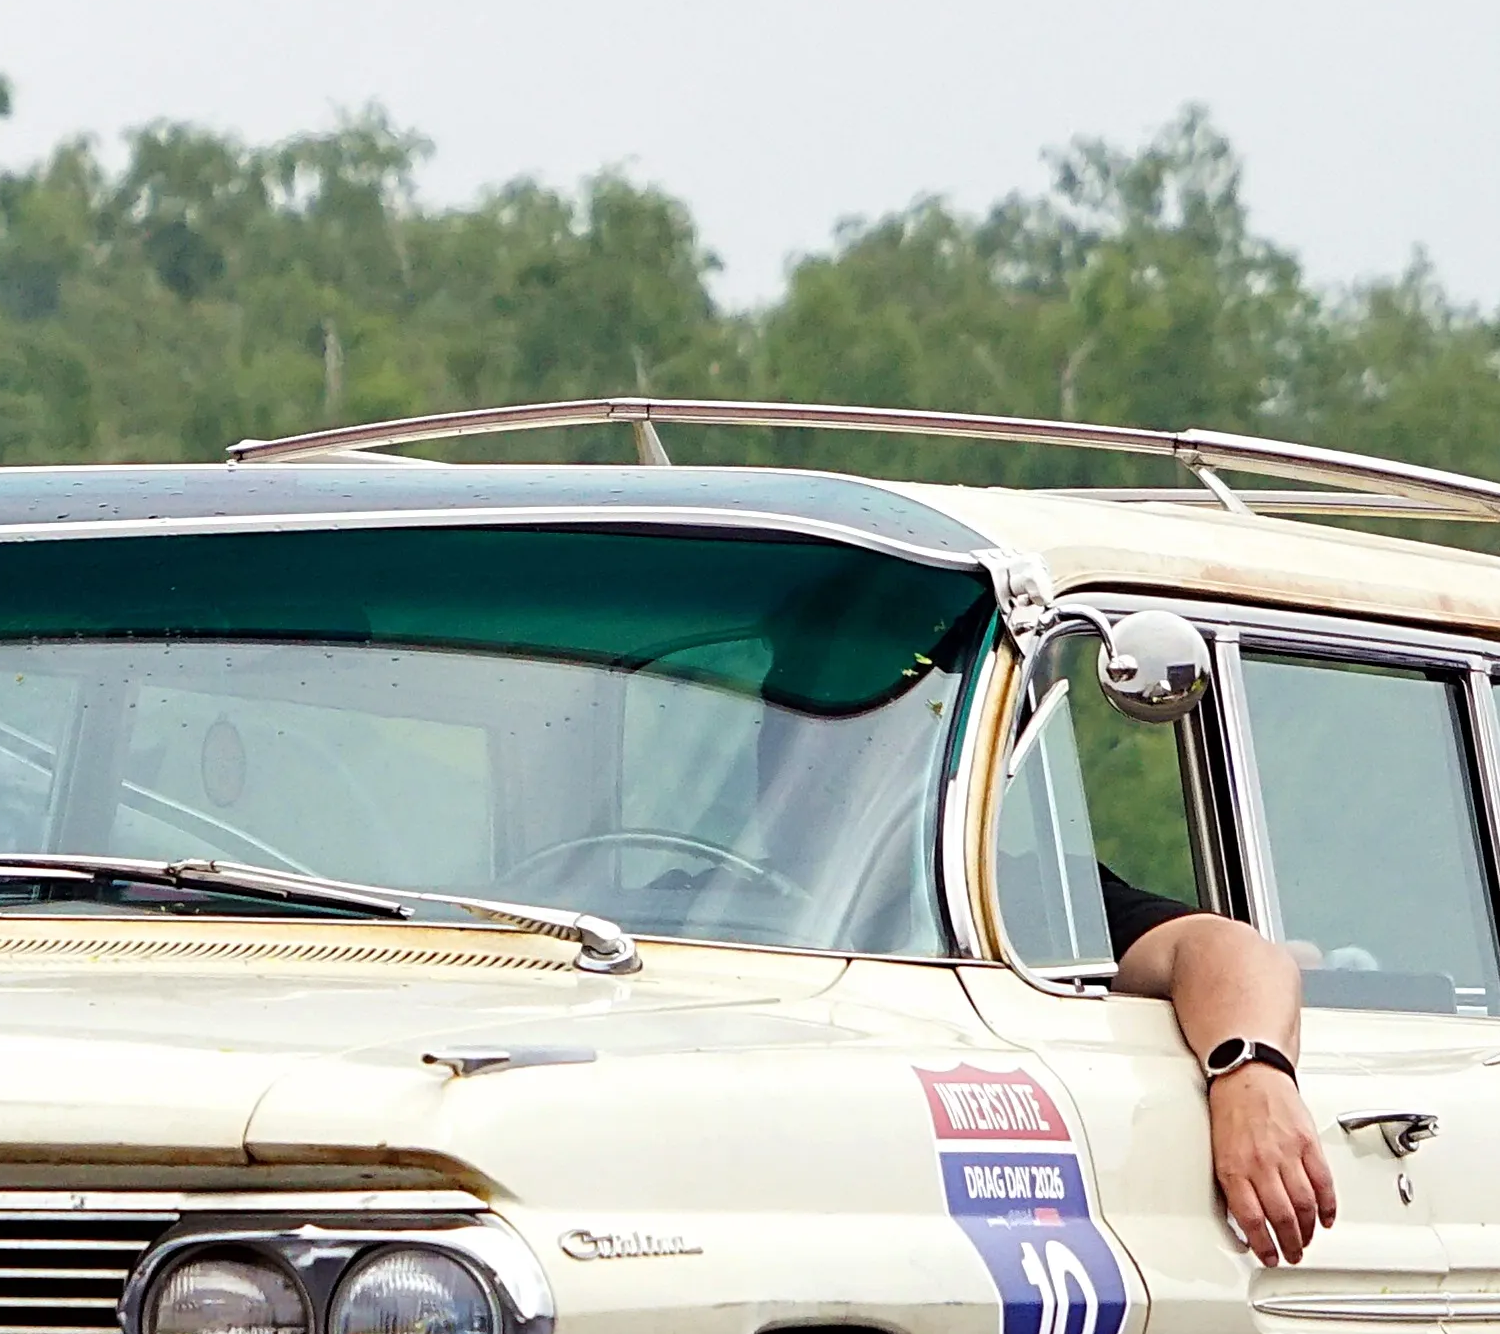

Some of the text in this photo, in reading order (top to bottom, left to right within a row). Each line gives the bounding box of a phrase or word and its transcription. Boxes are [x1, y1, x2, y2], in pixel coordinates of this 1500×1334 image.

[932, 1082, 1051, 1131] INTERSTATE
[963, 1165, 1065, 1200] DRAG DAY 2026
